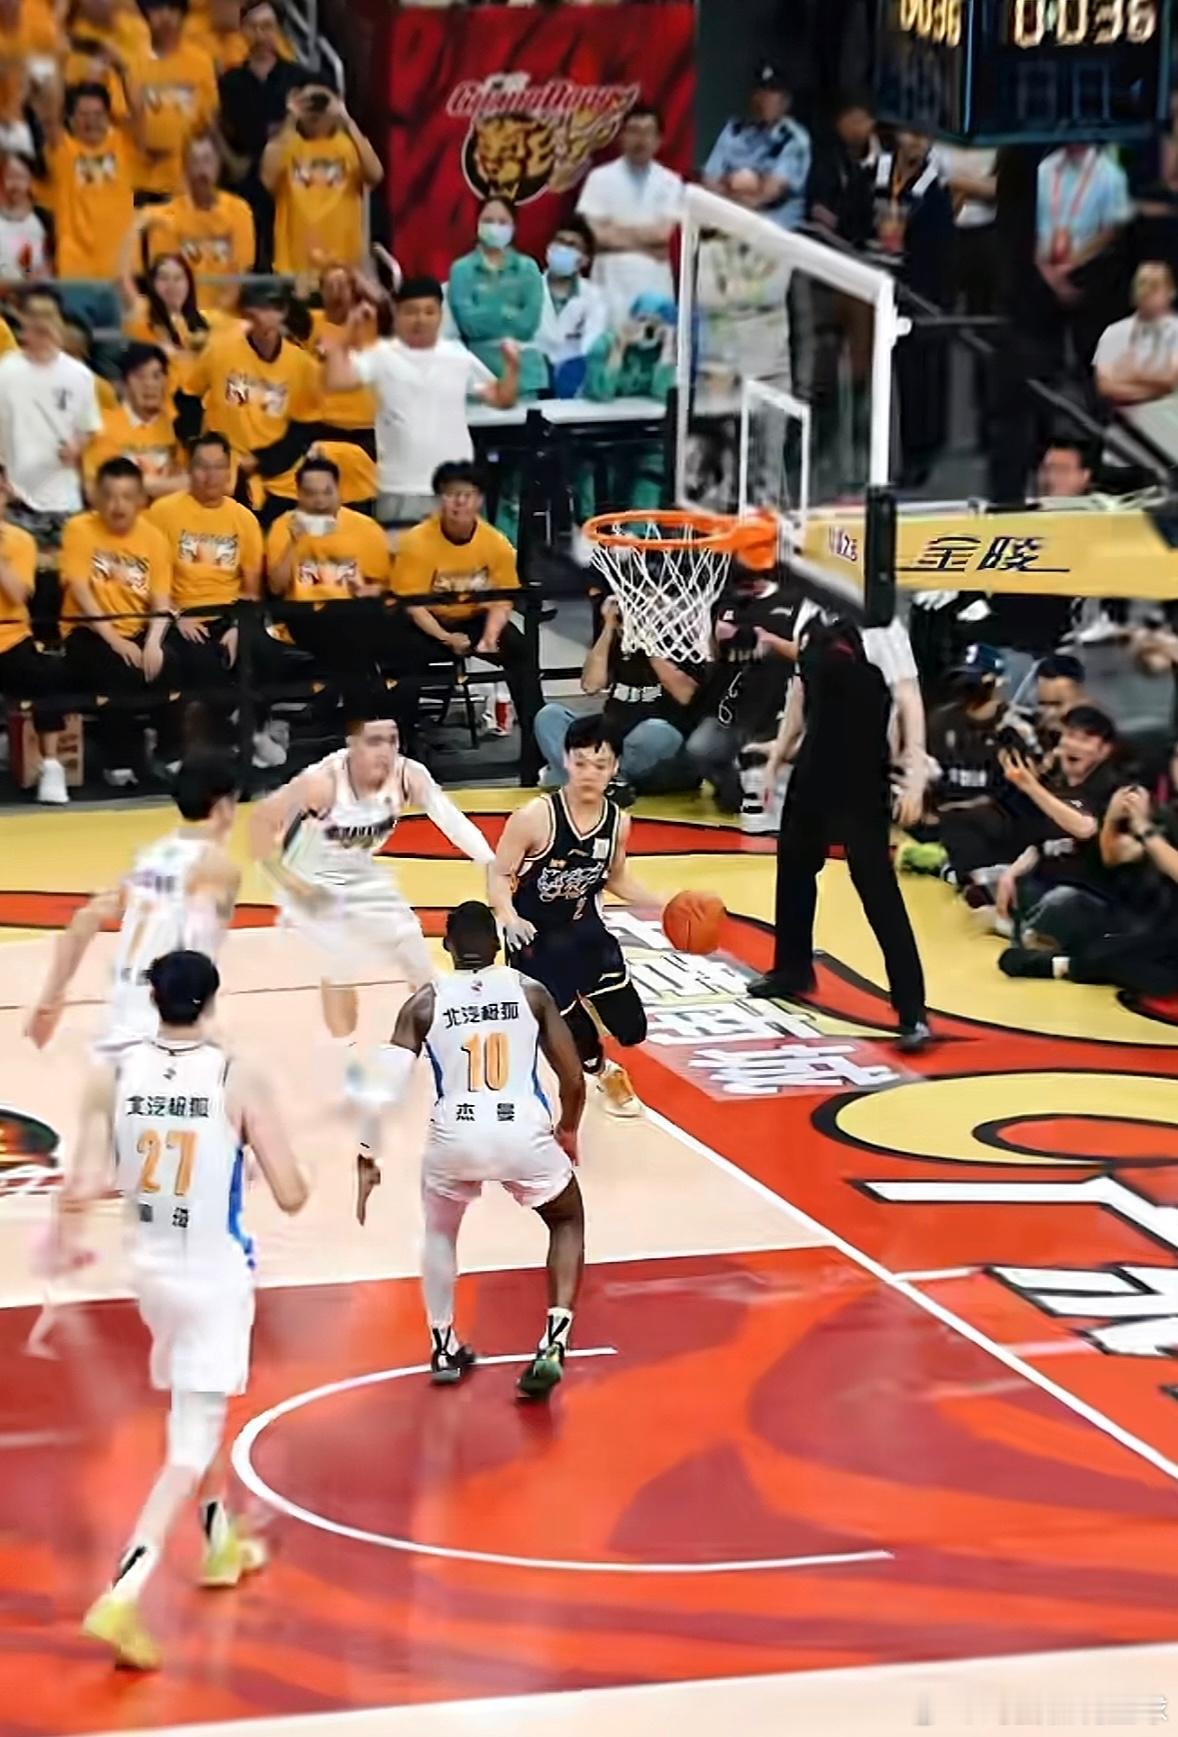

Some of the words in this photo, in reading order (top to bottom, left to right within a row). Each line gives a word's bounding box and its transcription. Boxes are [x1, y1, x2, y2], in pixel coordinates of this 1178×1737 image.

[442, 1001, 519, 1029] 北汽极狐
[461, 1032, 509, 1092] 10
[456, 1103, 515, 1121] 杰曼
[137, 1129, 198, 1196] 27
